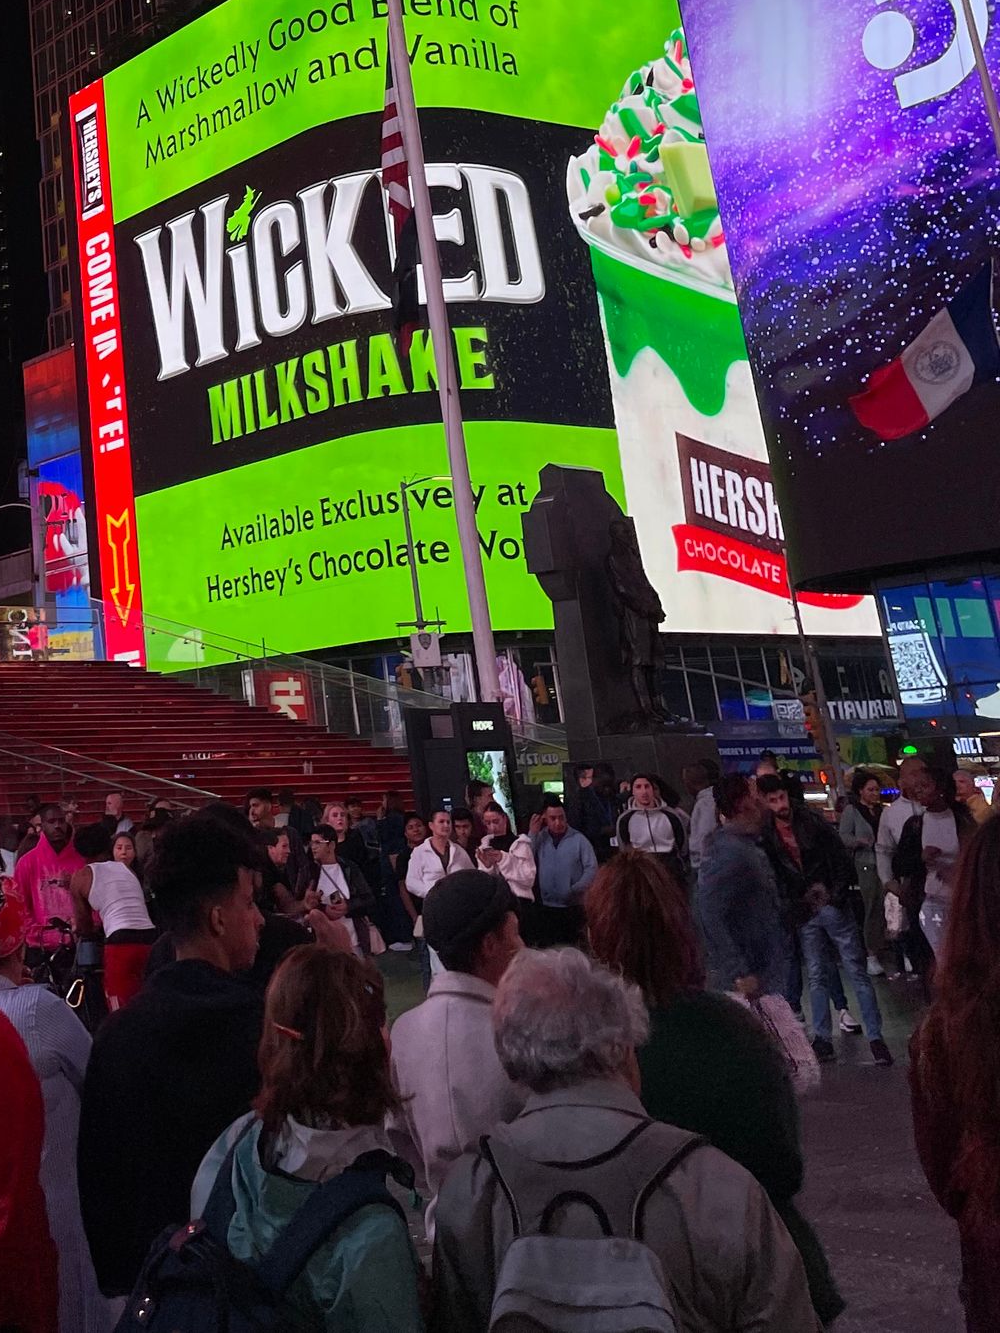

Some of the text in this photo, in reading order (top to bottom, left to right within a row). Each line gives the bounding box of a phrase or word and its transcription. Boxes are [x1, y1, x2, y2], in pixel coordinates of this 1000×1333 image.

[136, 98, 152, 129] A
[155, 38, 261, 115] Wickedly
[489, 0, 519, 30] of
[145, 68, 299, 169] Marshmallow
[308, 37, 381, 85] and
[85, 232, 117, 325] COME
[206, 326, 496, 446] MILKSHAKE
[220, 481, 529, 551] Available Exclusvey at
[689, 456, 786, 542] HERSH
[206, 557, 303, 603] Hershey's
[308, 538, 450, 582] Chocolate
[684, 538, 782, 584] CHOCOLATE
